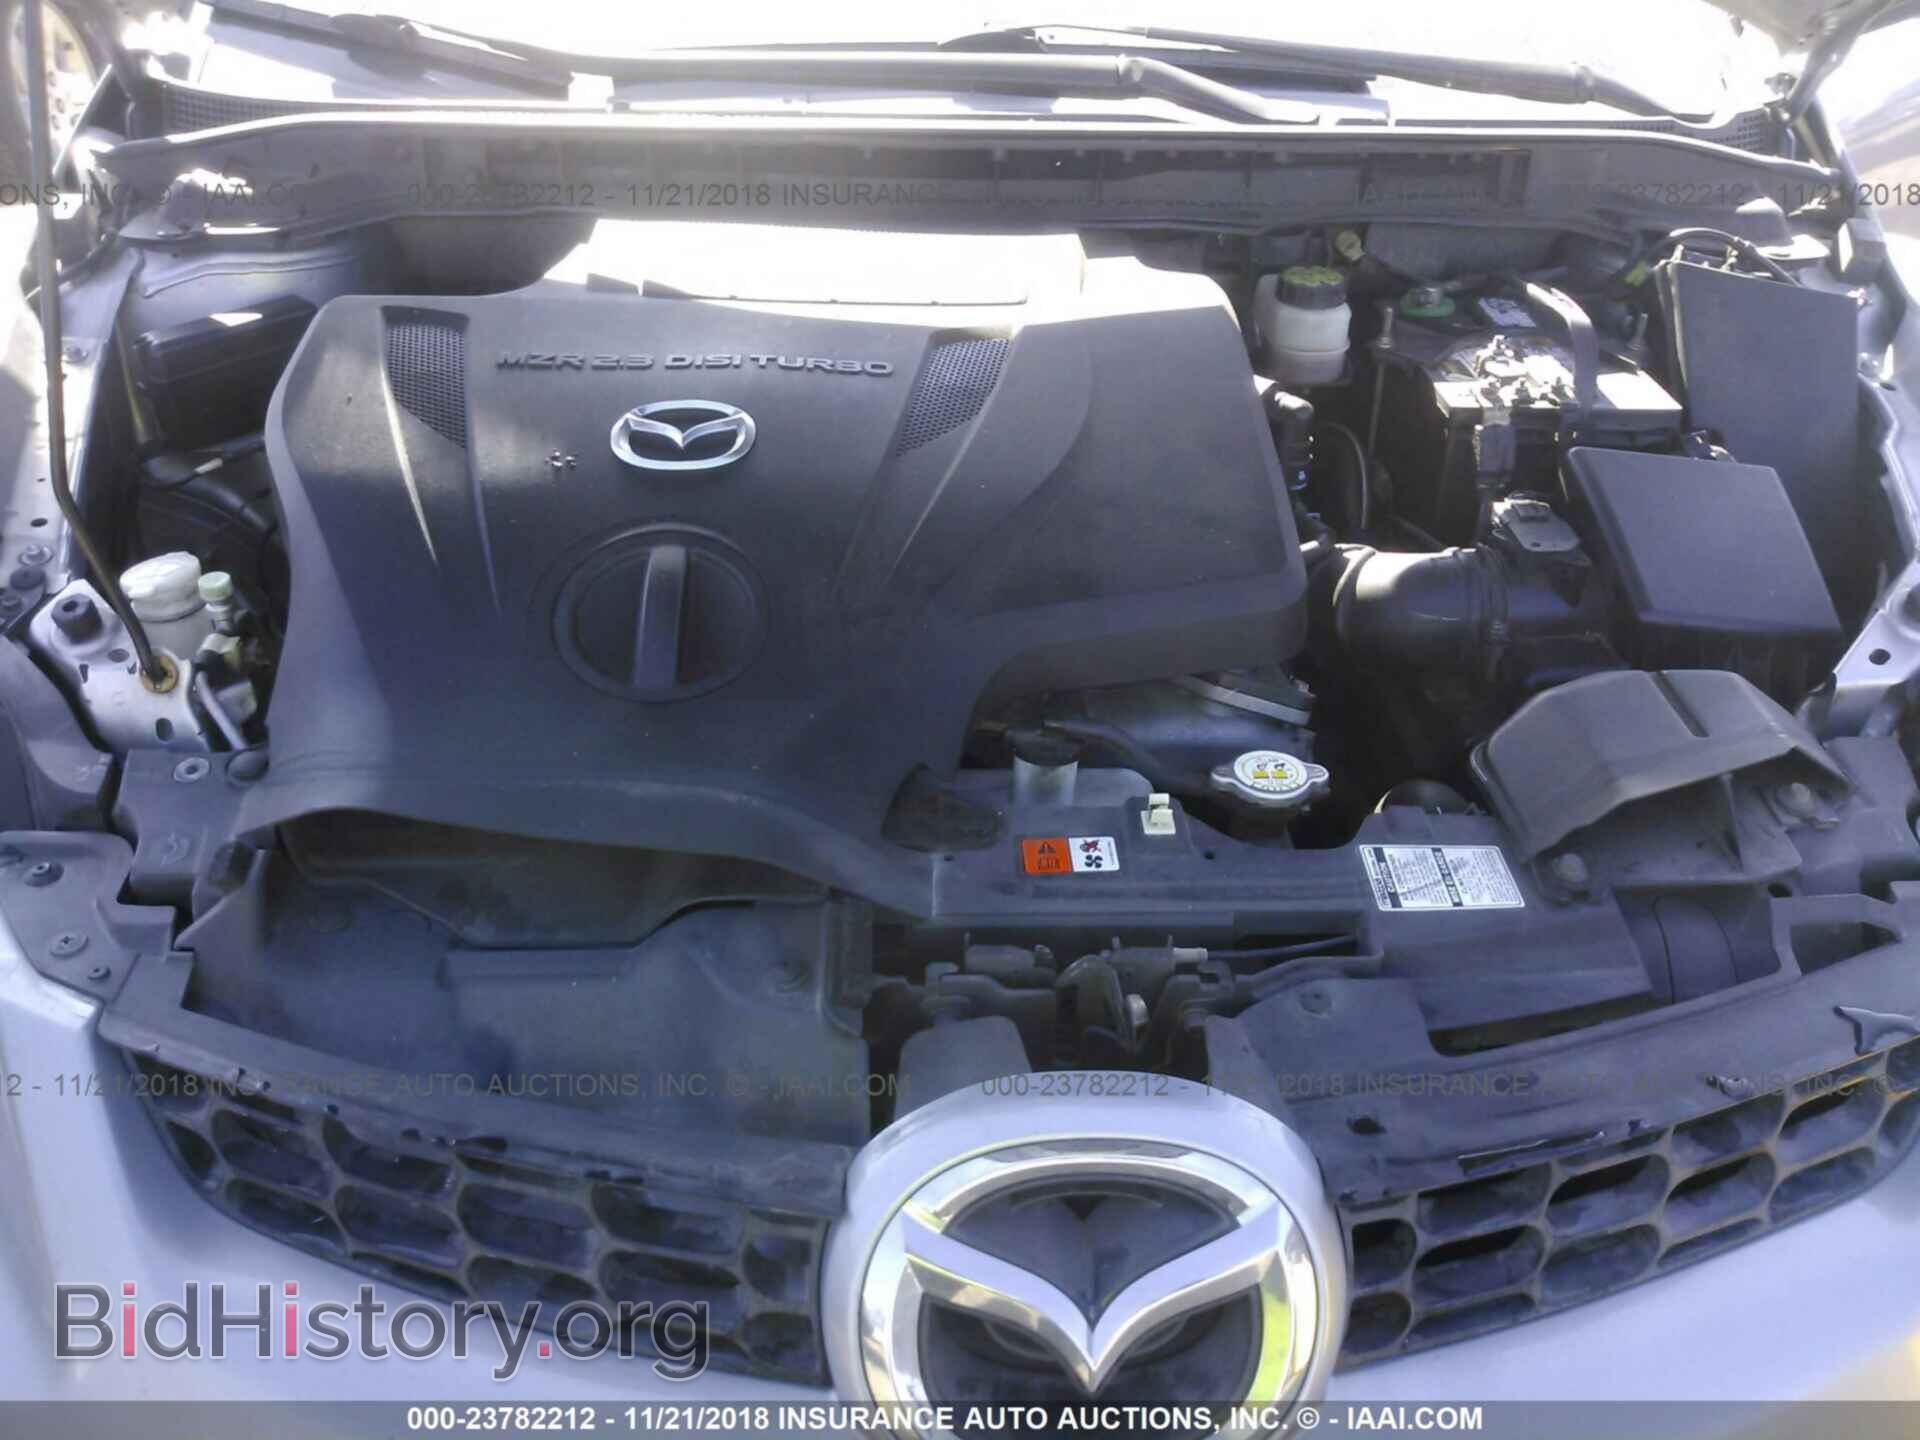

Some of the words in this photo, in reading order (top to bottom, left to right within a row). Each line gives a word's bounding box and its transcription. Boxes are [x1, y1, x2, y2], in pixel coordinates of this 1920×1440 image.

[496, 353, 584, 371] MZR
[664, 353, 742, 370] DISI
[750, 354, 894, 376] TURBO
